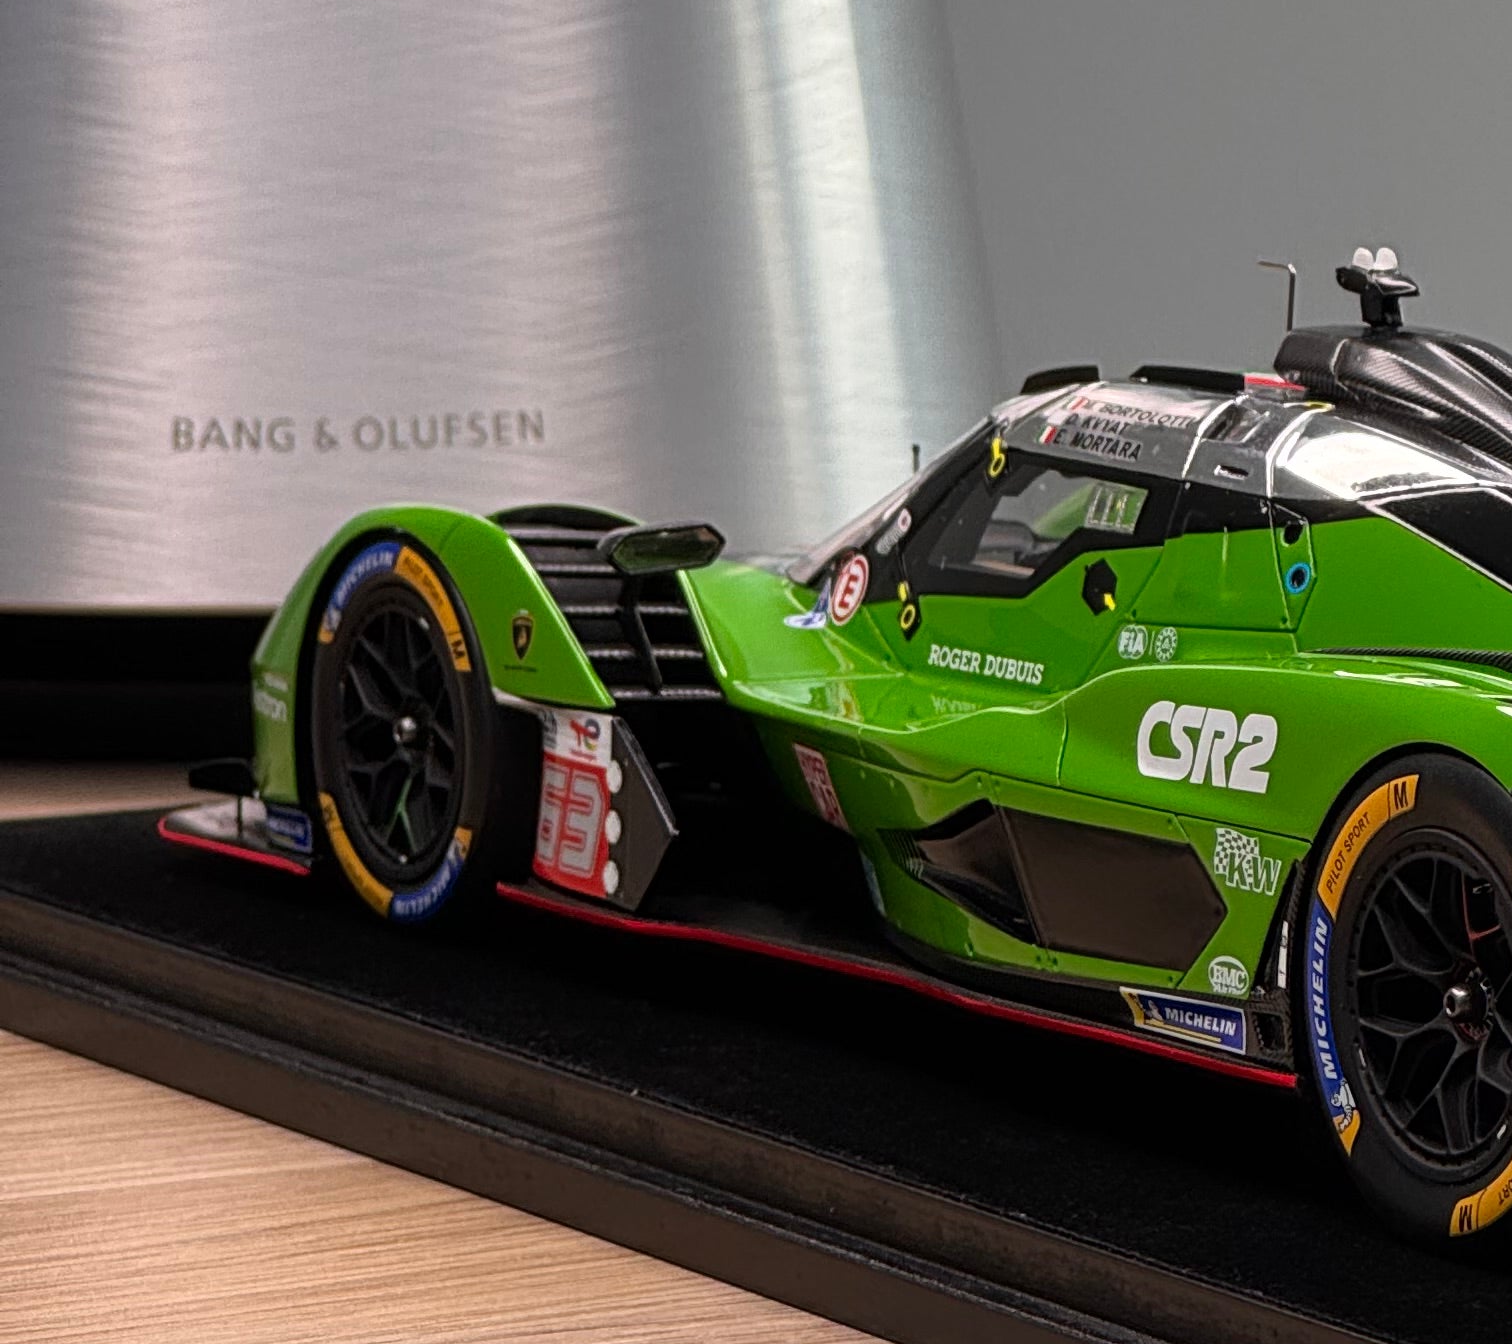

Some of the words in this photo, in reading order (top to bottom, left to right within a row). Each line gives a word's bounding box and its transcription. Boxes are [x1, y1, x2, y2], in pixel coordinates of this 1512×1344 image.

[171, 415, 296, 453] BANG
[314, 415, 339, 454] &
[351, 409, 546, 453] OLUFSEN
[1070, 431, 1142, 461] MORTARA
[1081, 415, 1130, 435] KVYAT
[928, 643, 981, 674] ROGER
[984, 655, 1044, 685] DUBUIS
[1137, 700, 1278, 794] CSR2
[1393, 780, 1409, 811] M
[1226, 853, 1281, 896] KW
[1326, 854, 1347, 895] PILOT
[1343, 812, 1371, 853] SPORT
[1309, 917, 1338, 1080] MICHELIN
[1164, 1006, 1237, 1036] MICHELIN
[1459, 1204, 1473, 1232] M
